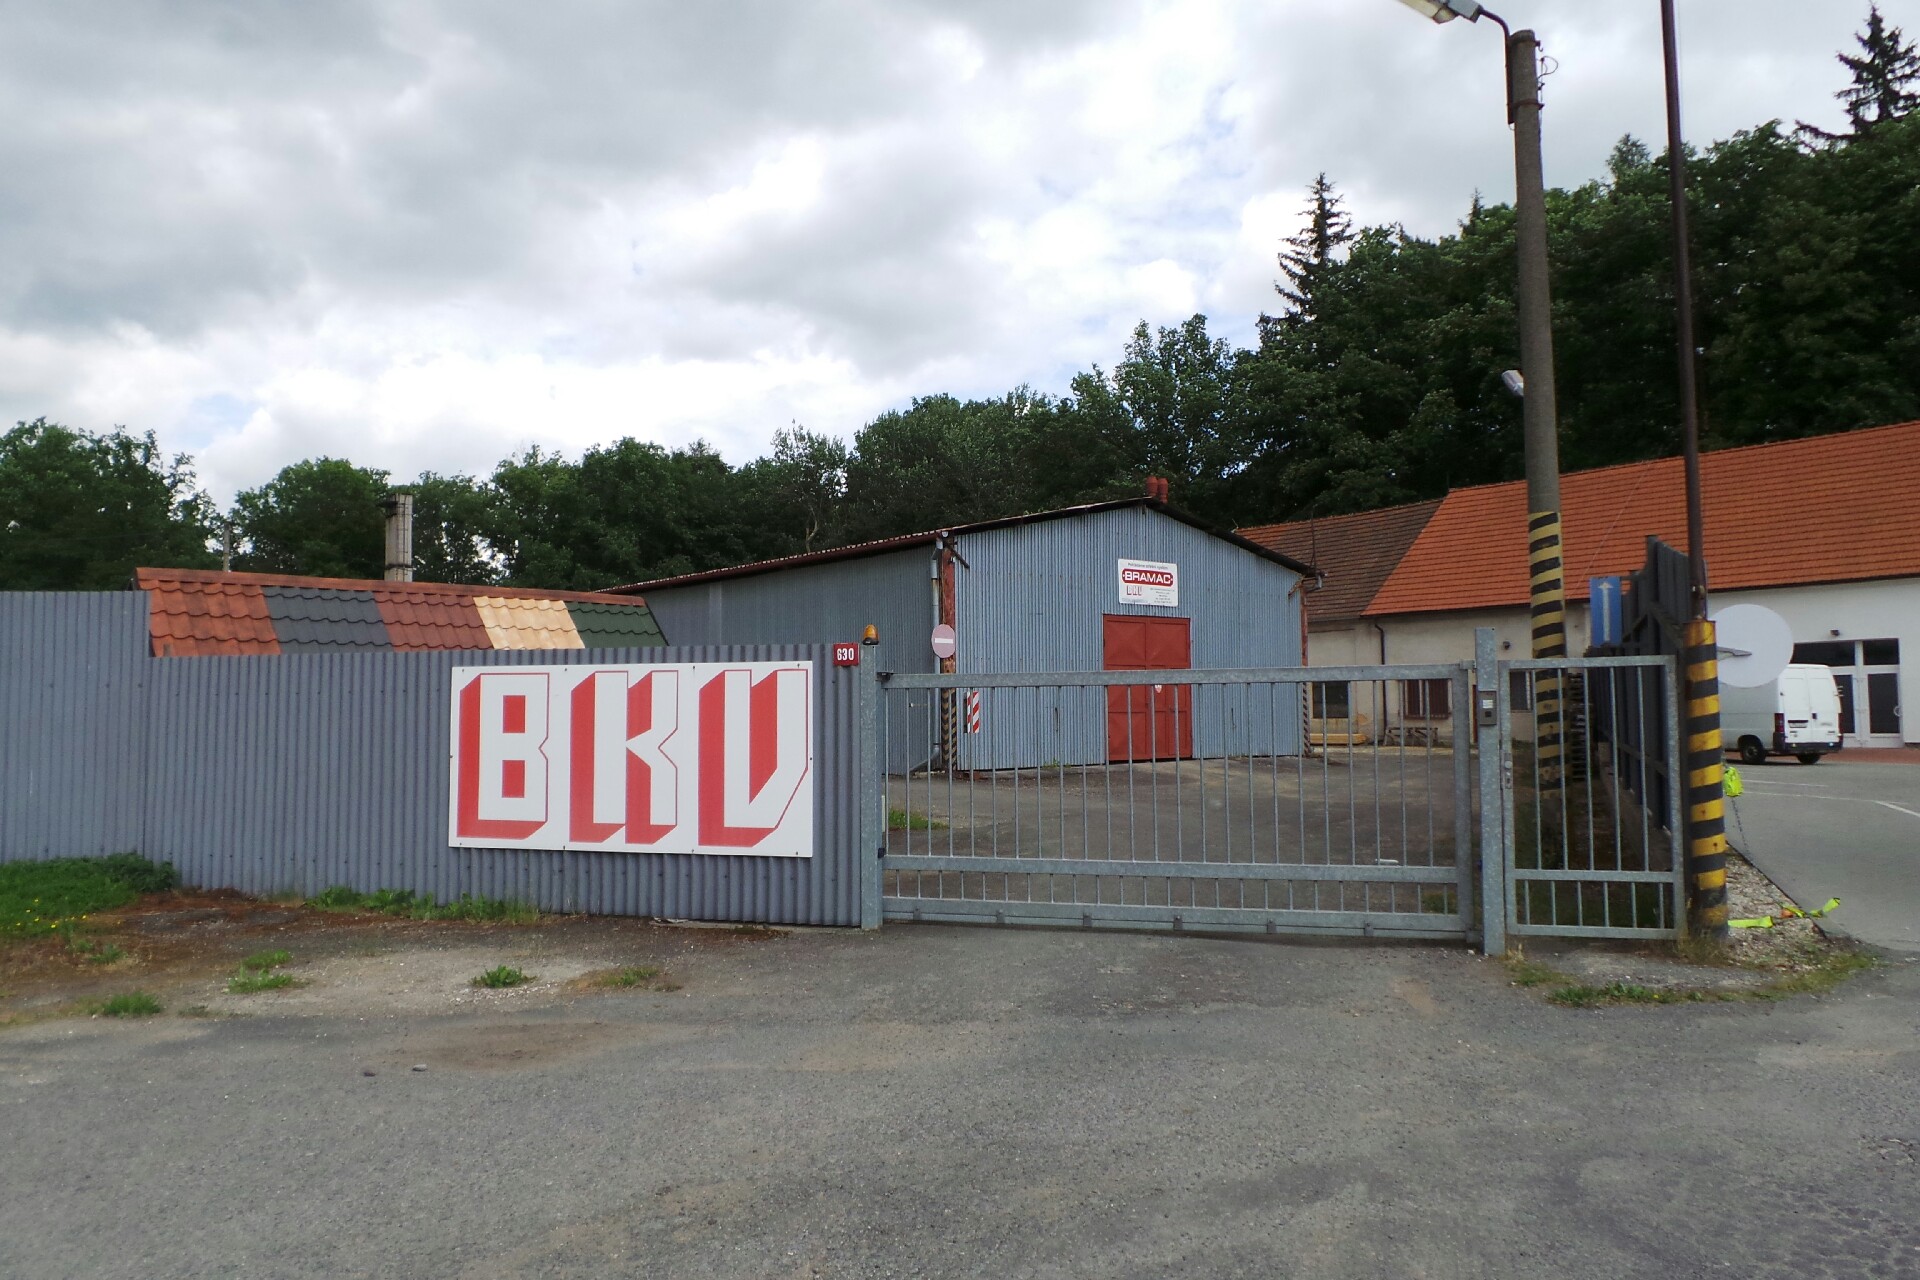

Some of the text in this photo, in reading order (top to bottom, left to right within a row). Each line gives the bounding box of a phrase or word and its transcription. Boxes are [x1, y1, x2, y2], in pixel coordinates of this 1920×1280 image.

[1124, 571, 1171, 584] BRAMAC
[836, 647, 855, 661] 630
[456, 668, 808, 848] BKV
